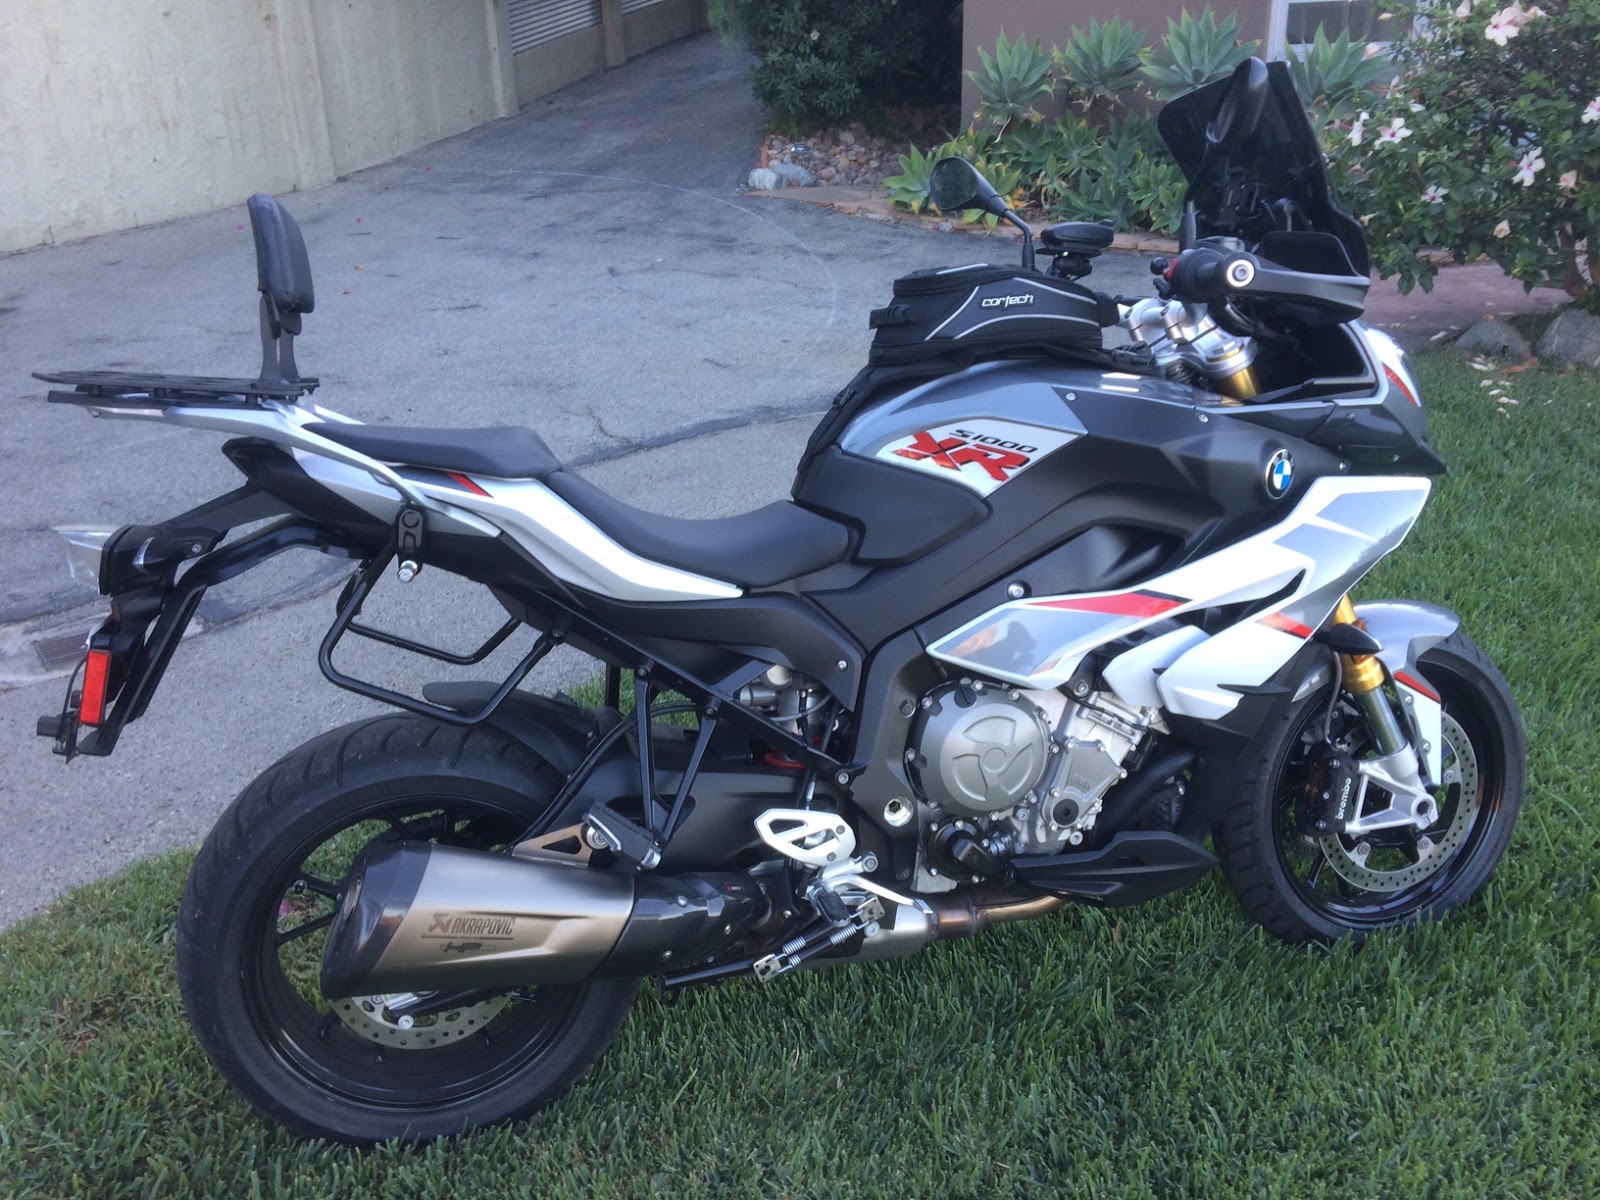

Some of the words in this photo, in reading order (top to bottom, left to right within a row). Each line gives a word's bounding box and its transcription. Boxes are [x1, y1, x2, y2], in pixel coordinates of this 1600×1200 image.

[981, 293, 1034, 307] cortech
[892, 431, 1031, 482] XR
[949, 429, 1038, 453] S1000
[1335, 777, 1352, 820] brembo
